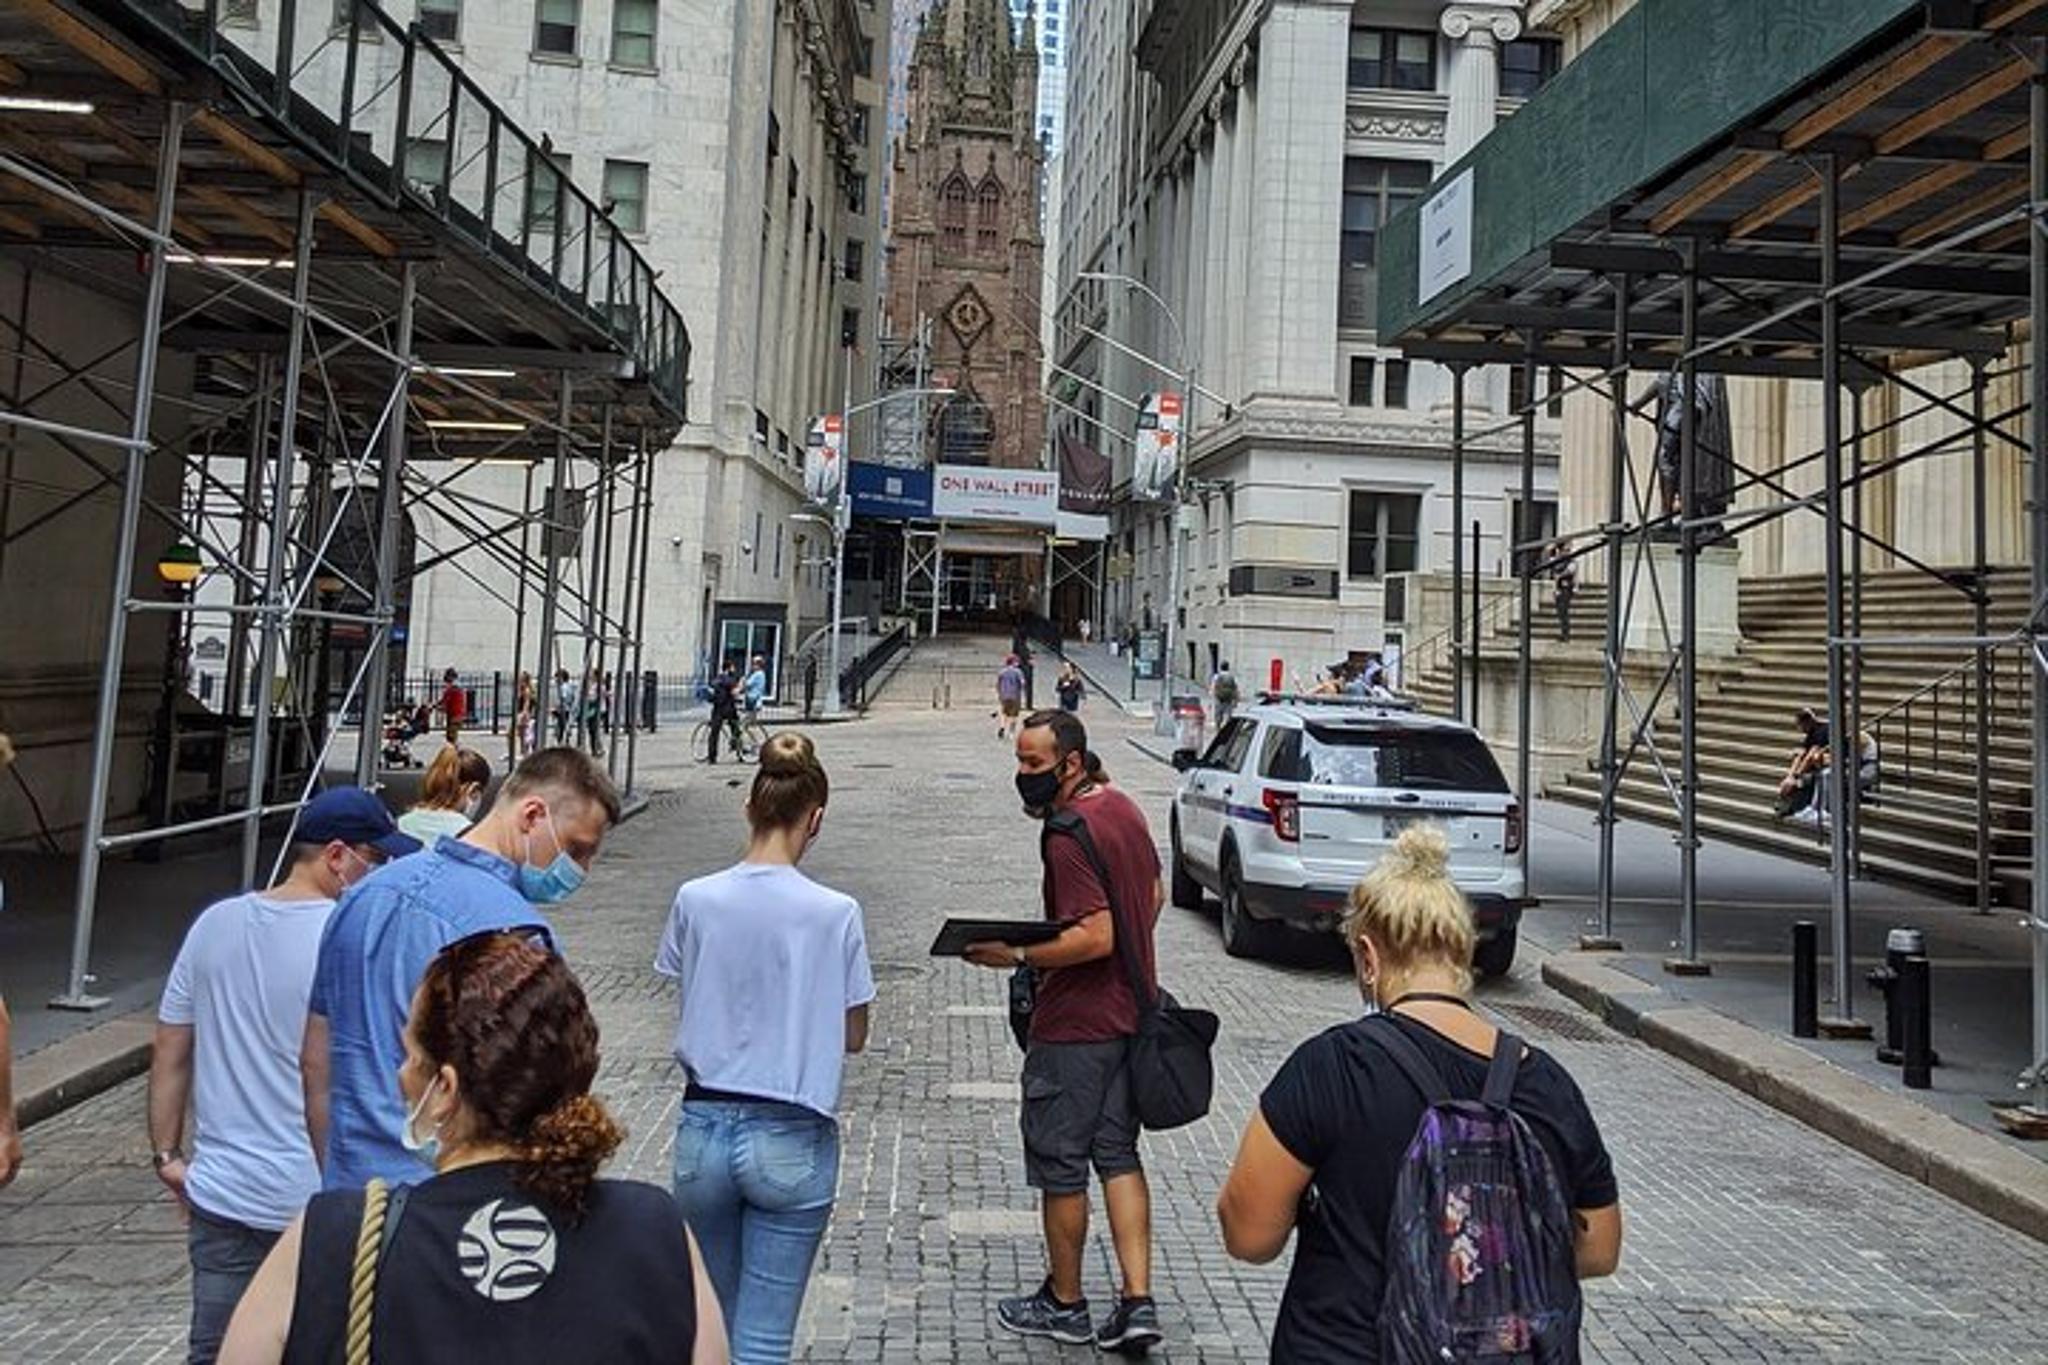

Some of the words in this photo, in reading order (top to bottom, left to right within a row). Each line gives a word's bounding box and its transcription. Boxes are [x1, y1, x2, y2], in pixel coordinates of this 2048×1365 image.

[941, 476, 968, 492] ONE
[973, 478, 1008, 494] WALL
[1013, 481, 1055, 497] STREET
